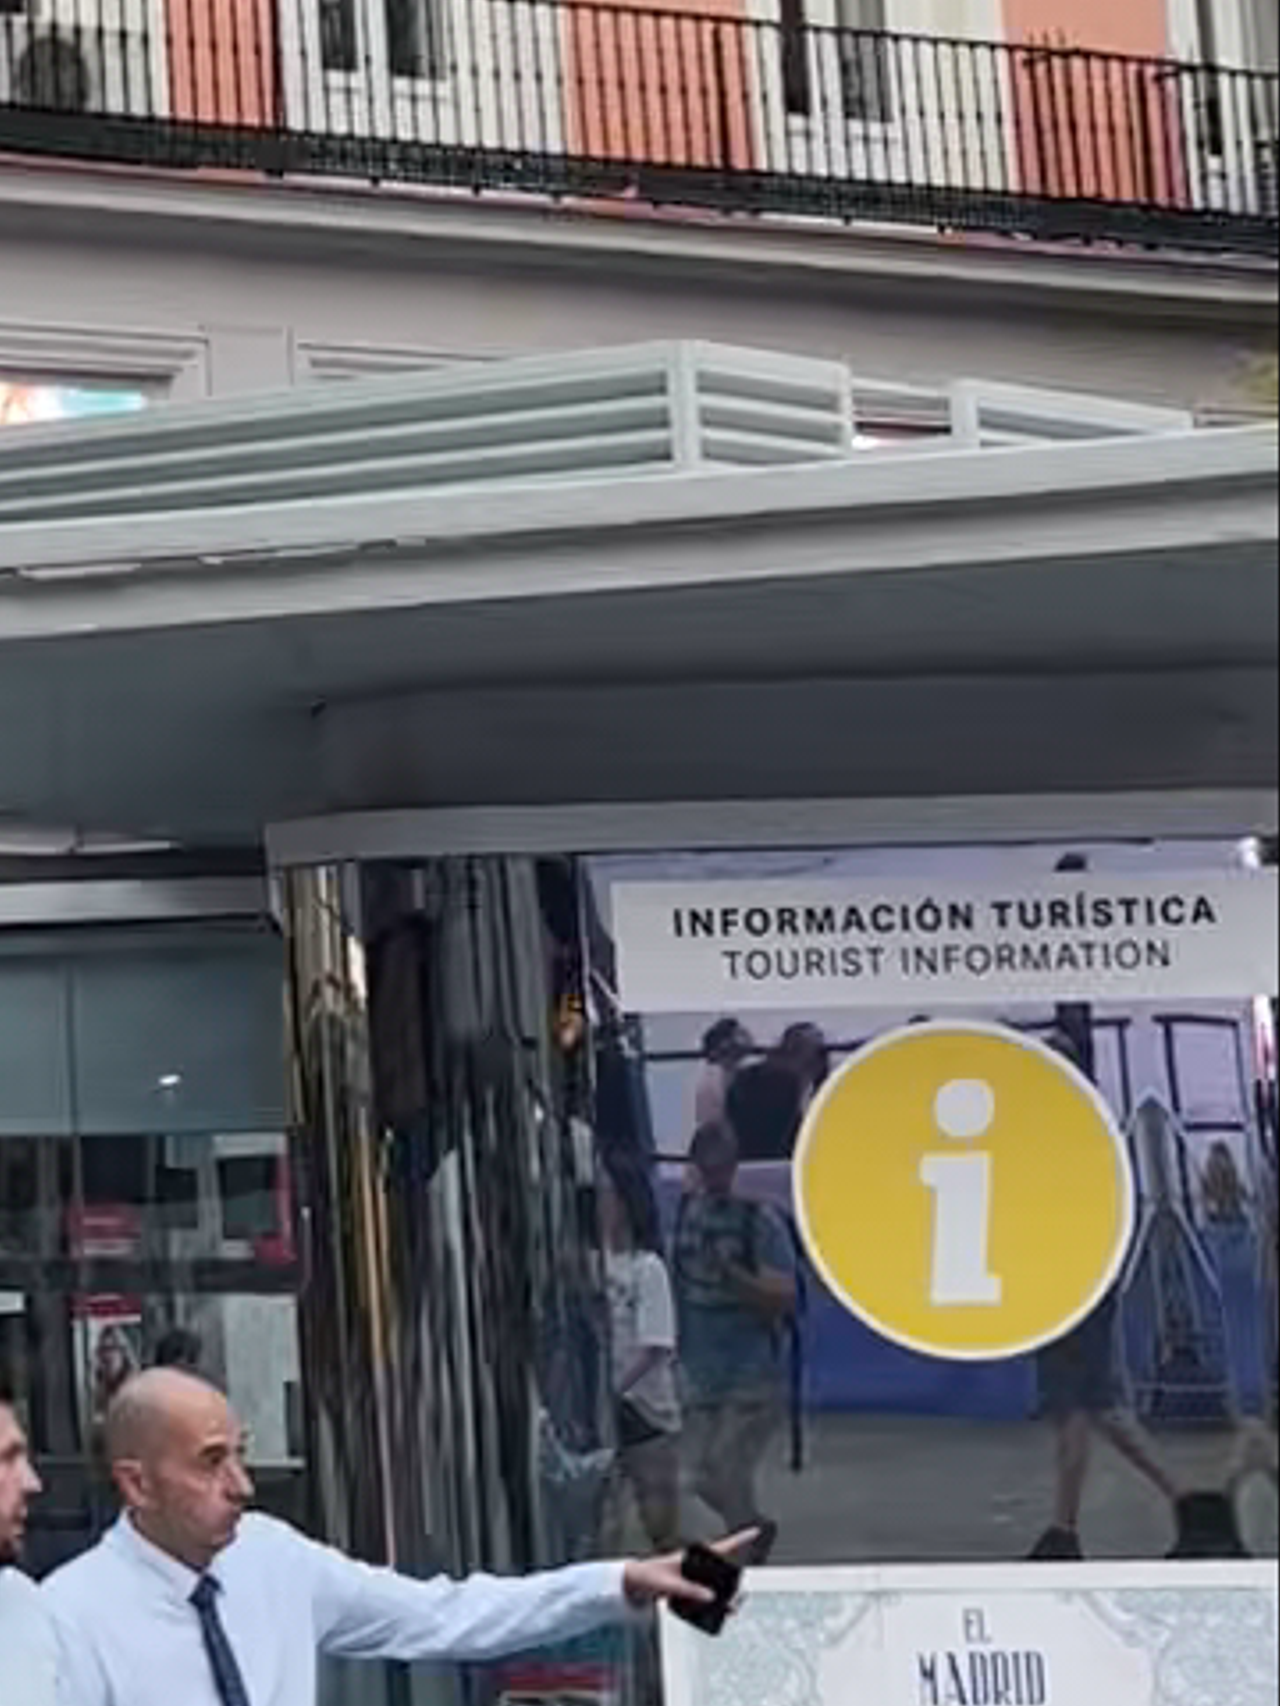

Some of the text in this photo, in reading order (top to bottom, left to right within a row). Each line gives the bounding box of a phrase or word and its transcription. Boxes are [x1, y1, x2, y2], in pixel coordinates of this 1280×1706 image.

[672, 890, 1218, 938] INFORMACIÓN TURÍSTICA
[721, 938, 1171, 981] TOURIST INFORMATION
[963, 1607, 990, 1643] EL
[917, 1651, 1047, 1706] MADRID
